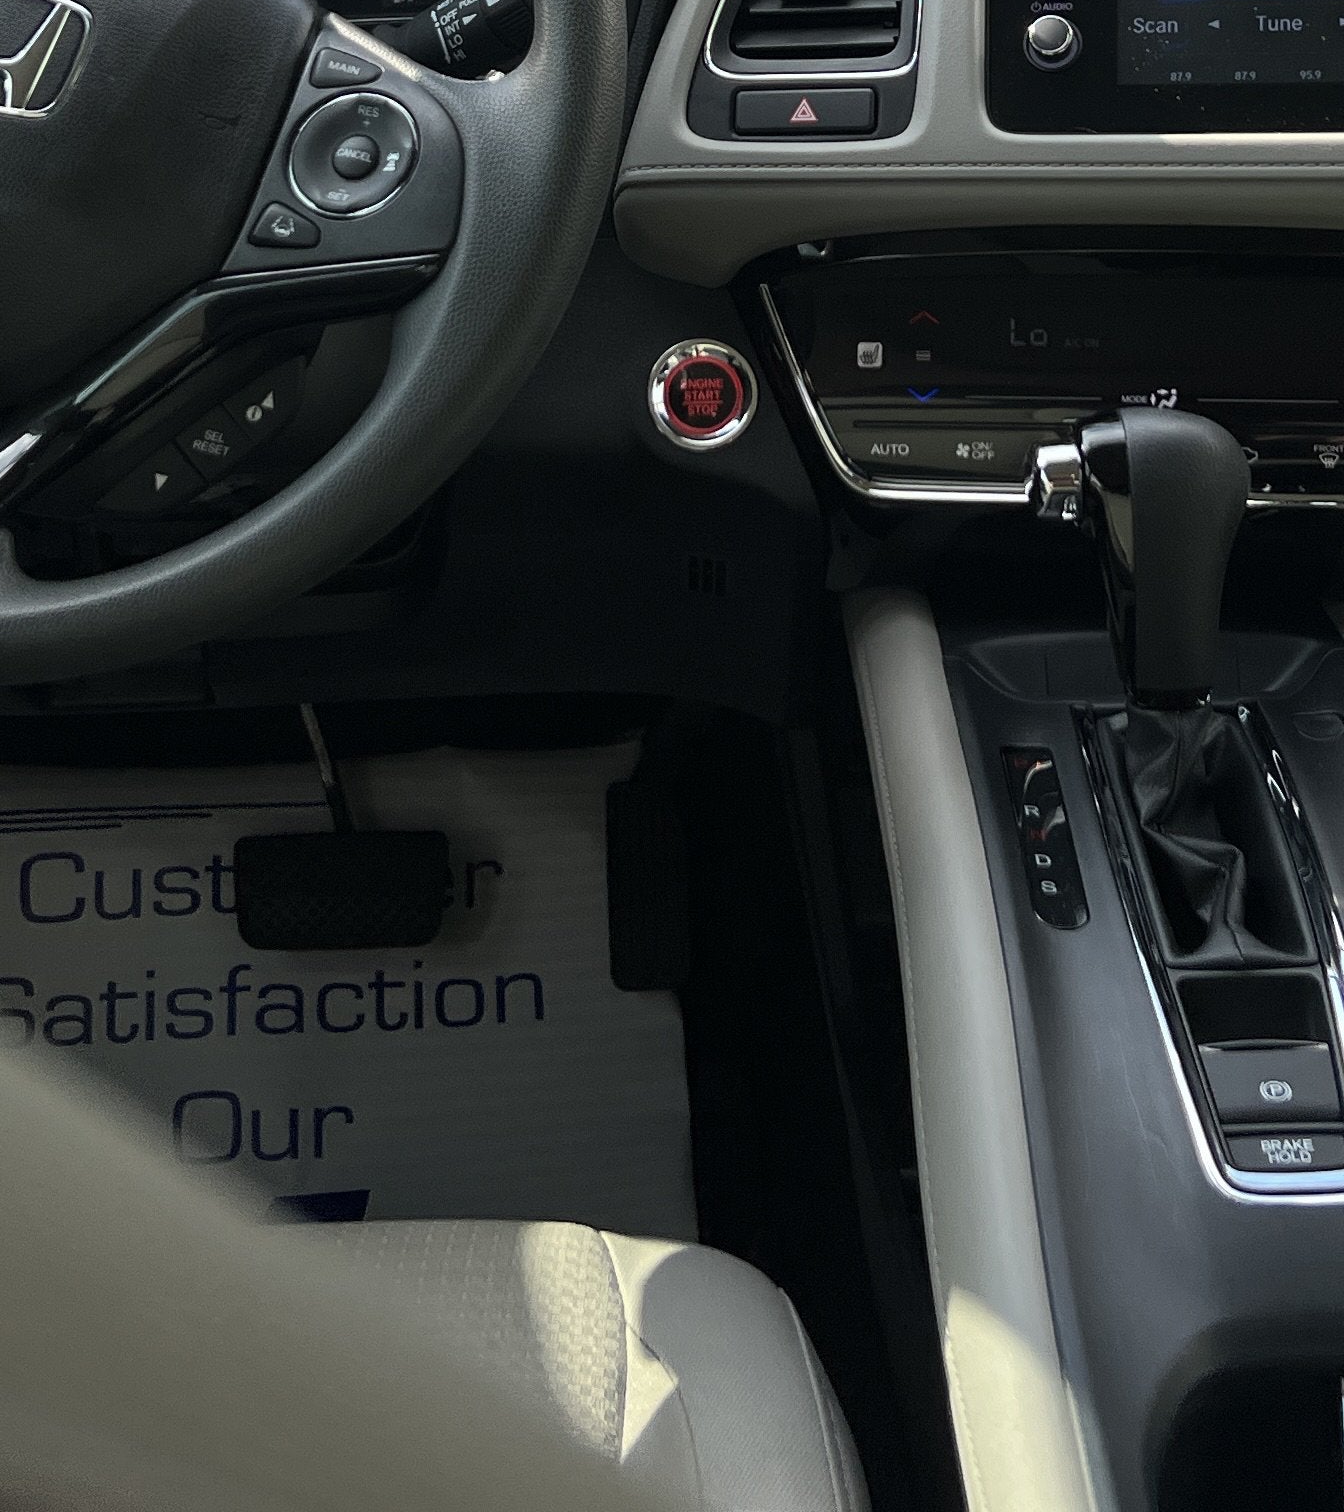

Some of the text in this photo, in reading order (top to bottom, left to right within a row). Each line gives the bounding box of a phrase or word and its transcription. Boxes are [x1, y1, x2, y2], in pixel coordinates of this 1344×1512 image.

[1043, 2, 1073, 11] AUDIO
[439, 8, 458, 26] OFF
[1256, 15, 1303, 32] Tune
[444, 19, 461, 36] INT
[1133, 17, 1179, 34] Scan
[449, 33, 463, 49] LO
[454, 49, 467, 62] HI
[328, 60, 361, 76] MAIN
[1299, 70, 1322, 80] 95.9
[1170, 71, 1192, 81] 87.9
[1234, 71, 1256, 81] 87.9
[358, 104, 380, 118] RES
[336, 147, 372, 163] CANCEL
[327, 191, 350, 201] SET
[1010, 317, 1048, 347] Lo
[680, 377, 724, 389] ENGINE
[684, 390, 721, 400] START
[1121, 394, 1147, 403] MODE
[687, 404, 718, 417] STOP
[204, 429, 225, 443] SEL
[193, 439, 230, 456] RESET
[871, 443, 909, 456] AUTO
[972, 441, 993, 451] ON/
[1313, 444, 1344, 453] FRONT
[972, 450, 994, 460] OFF
[1024, 805, 1040, 818] R
[1034, 853, 1052, 868] D
[19, 851, 504, 924] Custr
[1041, 880, 1057, 895] S
[172, 1090, 354, 1165] Our
[1260, 1138, 1315, 1153] BRAKE
[1267, 1149, 1312, 1164] HOLD
